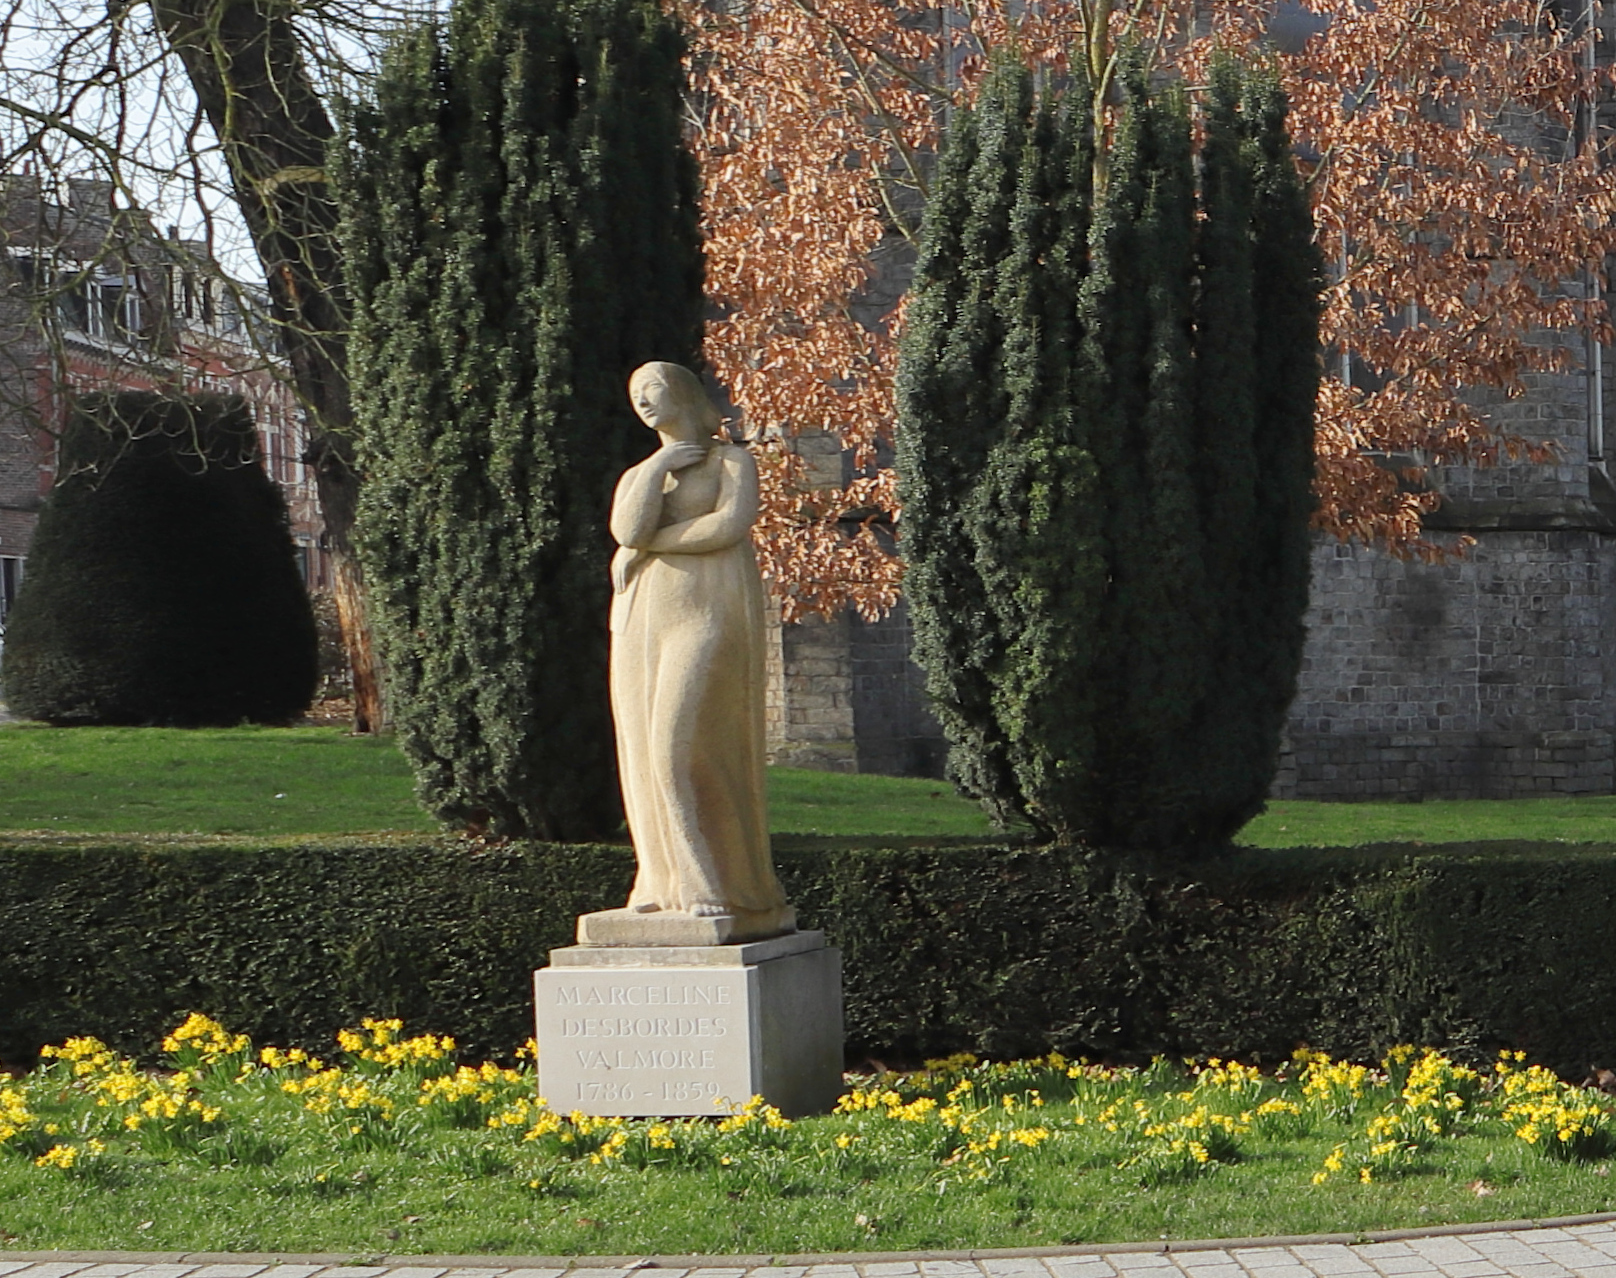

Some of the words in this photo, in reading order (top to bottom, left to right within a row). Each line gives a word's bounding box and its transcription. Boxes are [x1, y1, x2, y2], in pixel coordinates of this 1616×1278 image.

[556, 985, 731, 1006] MARCELINE
[562, 1017, 727, 1038] DESBORDES
[576, 1049, 716, 1070] VALMORE
[577, 1082, 634, 1102] 1786
[662, 1081, 721, 1101] 1859
